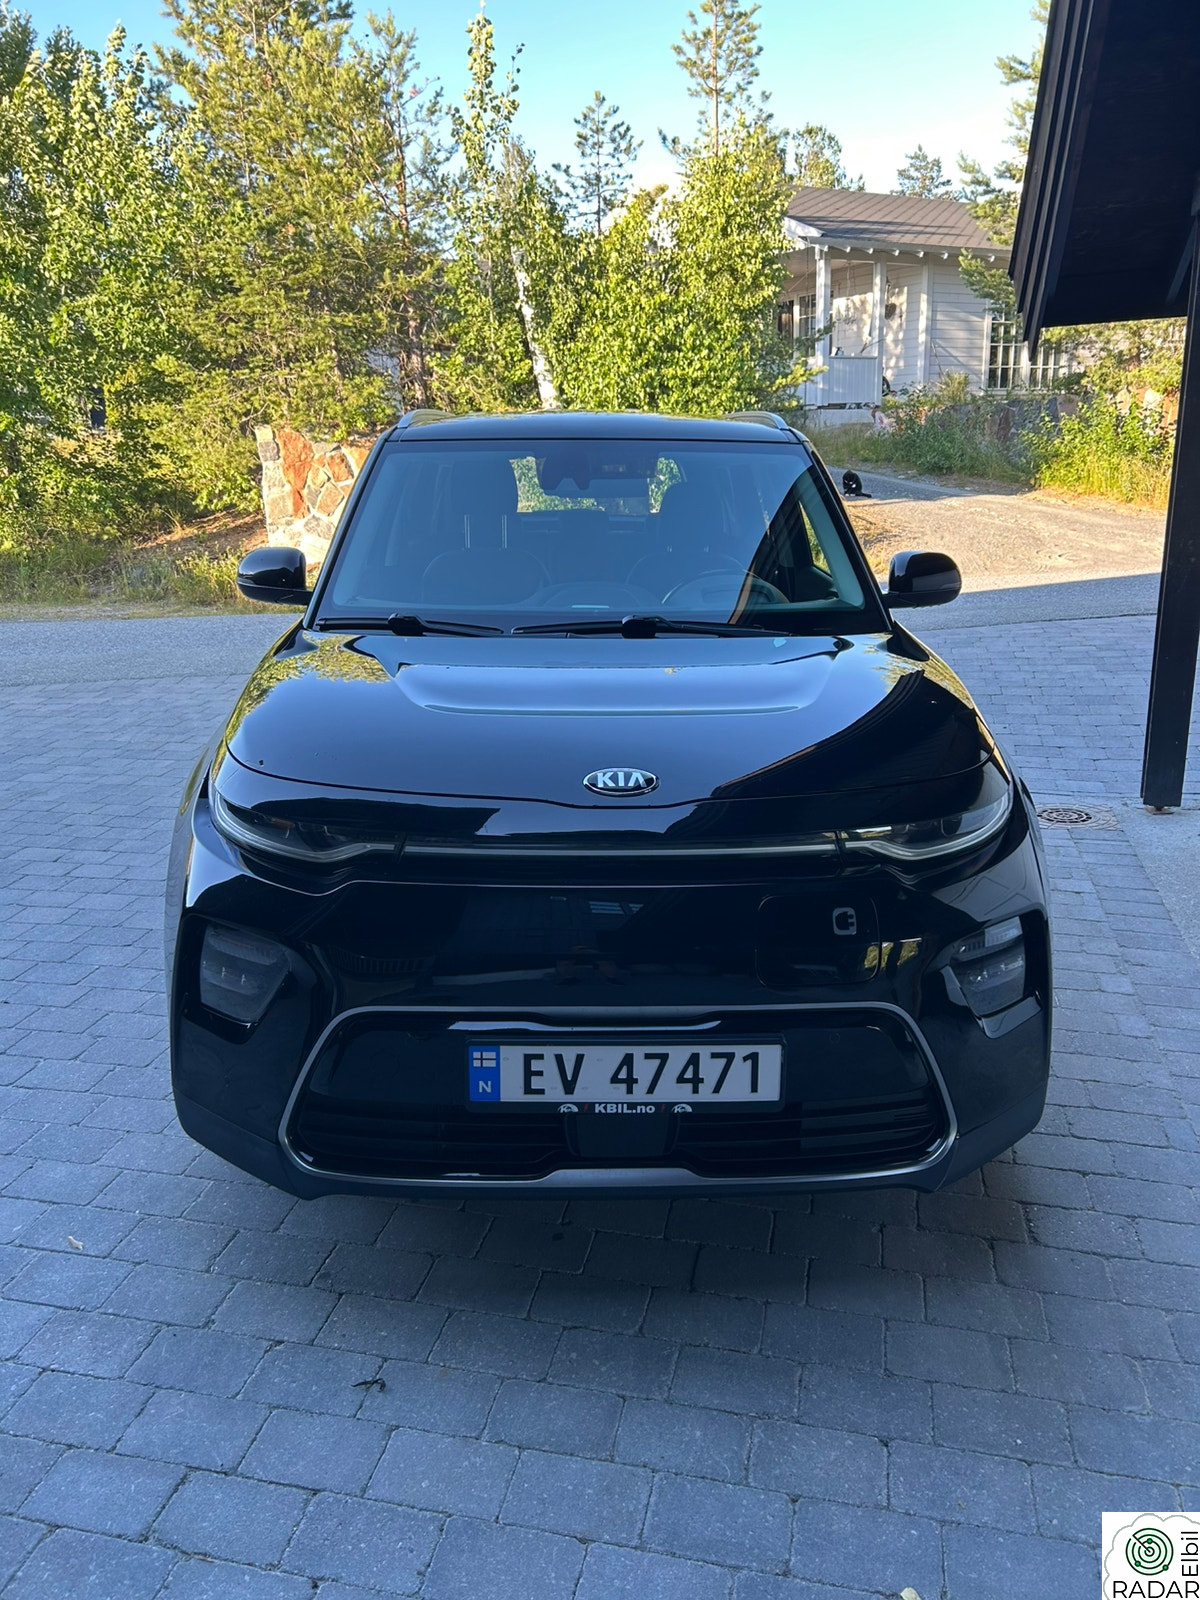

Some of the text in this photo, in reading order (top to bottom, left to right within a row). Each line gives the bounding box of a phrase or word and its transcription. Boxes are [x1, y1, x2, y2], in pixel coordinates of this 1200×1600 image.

[597, 771, 647, 788] KIA
[523, 1052, 760, 1095] EV 47471
[478, 1080, 492, 1093] N
[594, 1103, 656, 1114] KBIL.no
